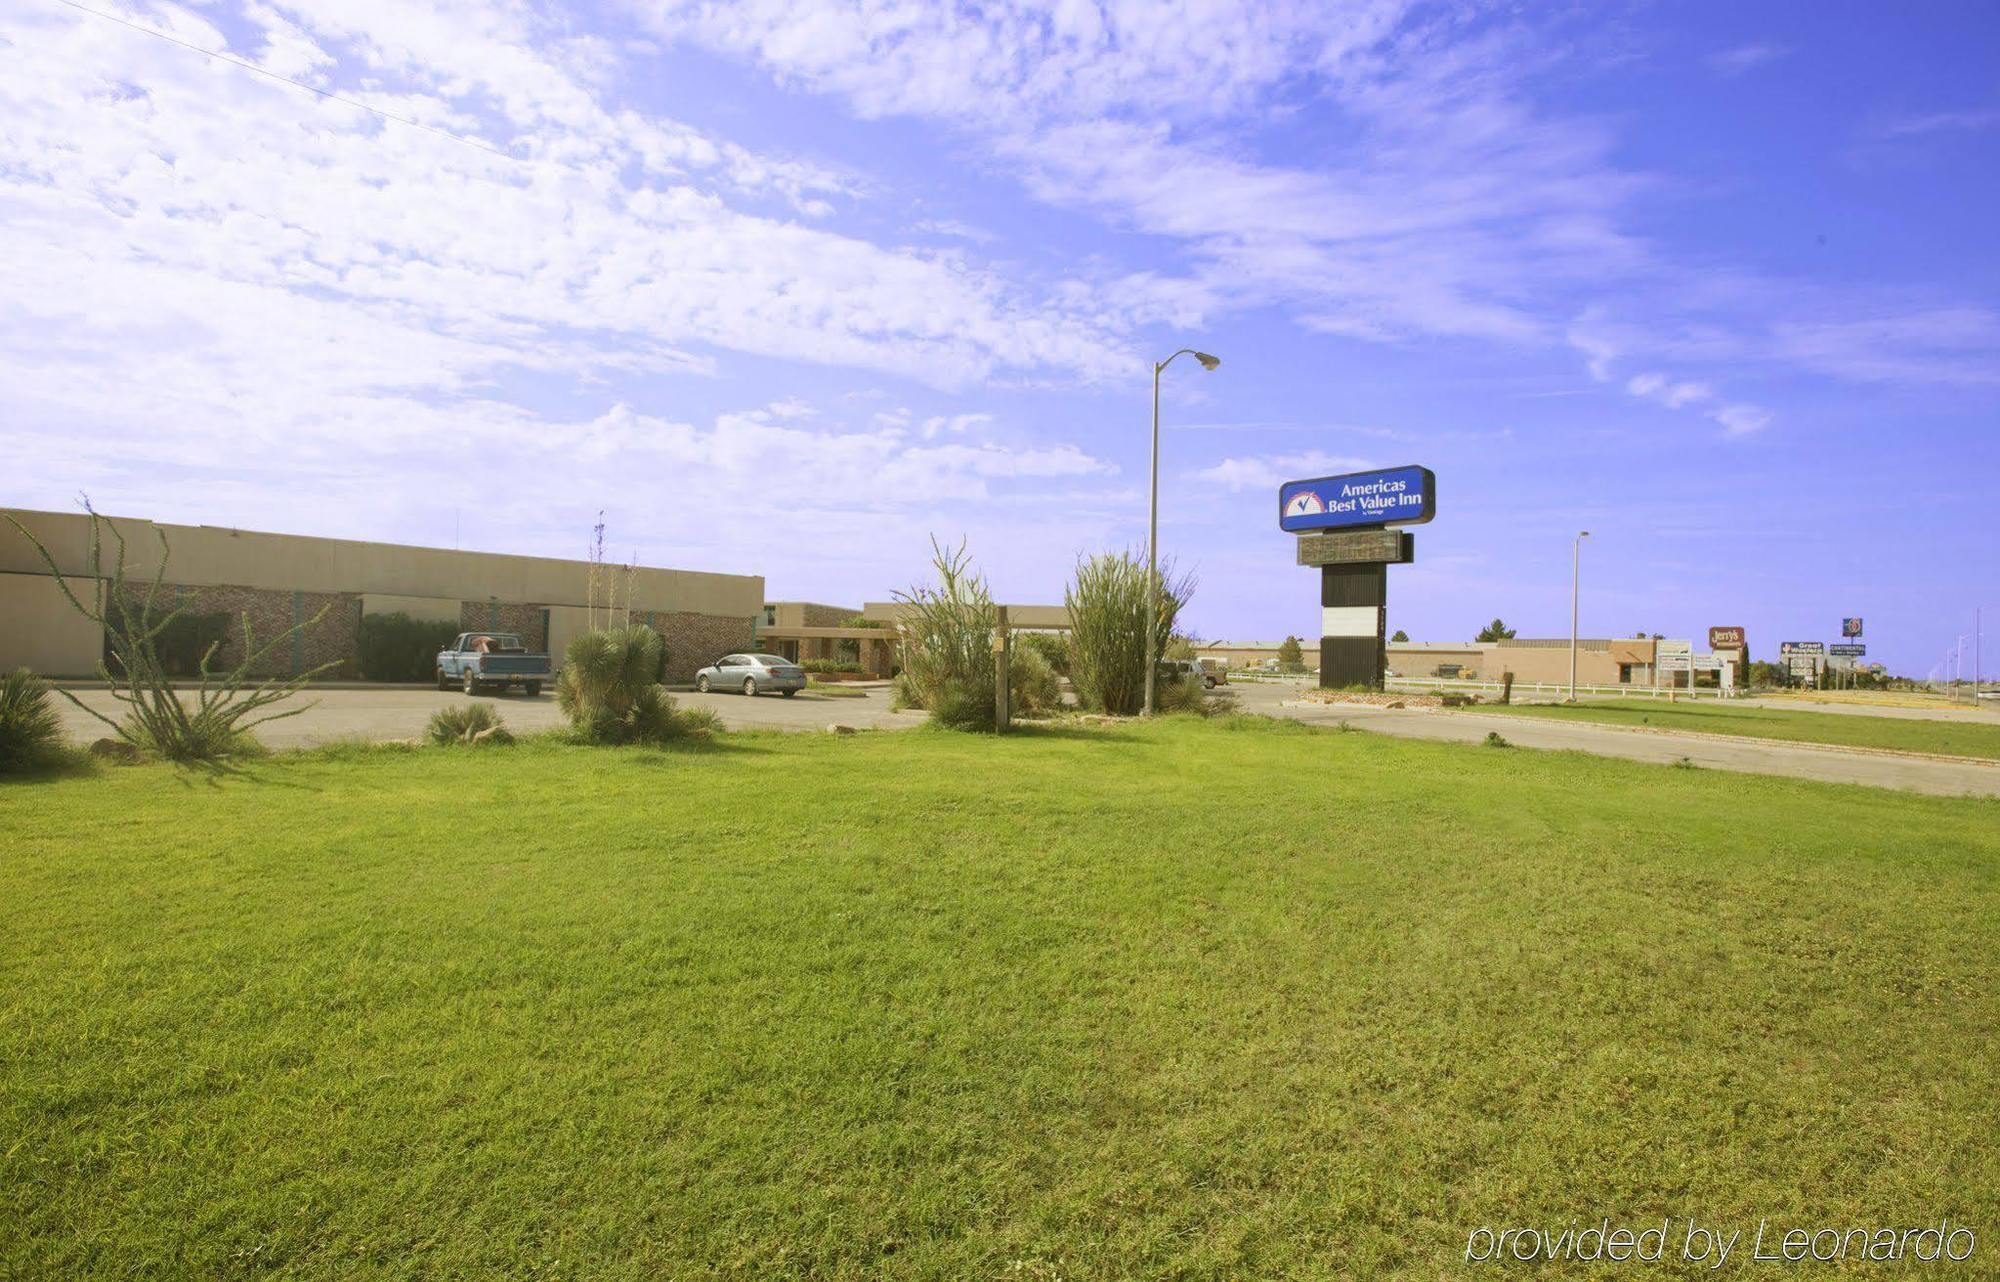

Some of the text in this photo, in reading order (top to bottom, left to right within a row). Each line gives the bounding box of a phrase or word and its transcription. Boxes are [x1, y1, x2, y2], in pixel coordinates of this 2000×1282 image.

[1341, 480, 1406, 497] Americas
[1329, 493, 1422, 513] Best Value Inn
[1712, 630, 1738, 643] Jerry's
